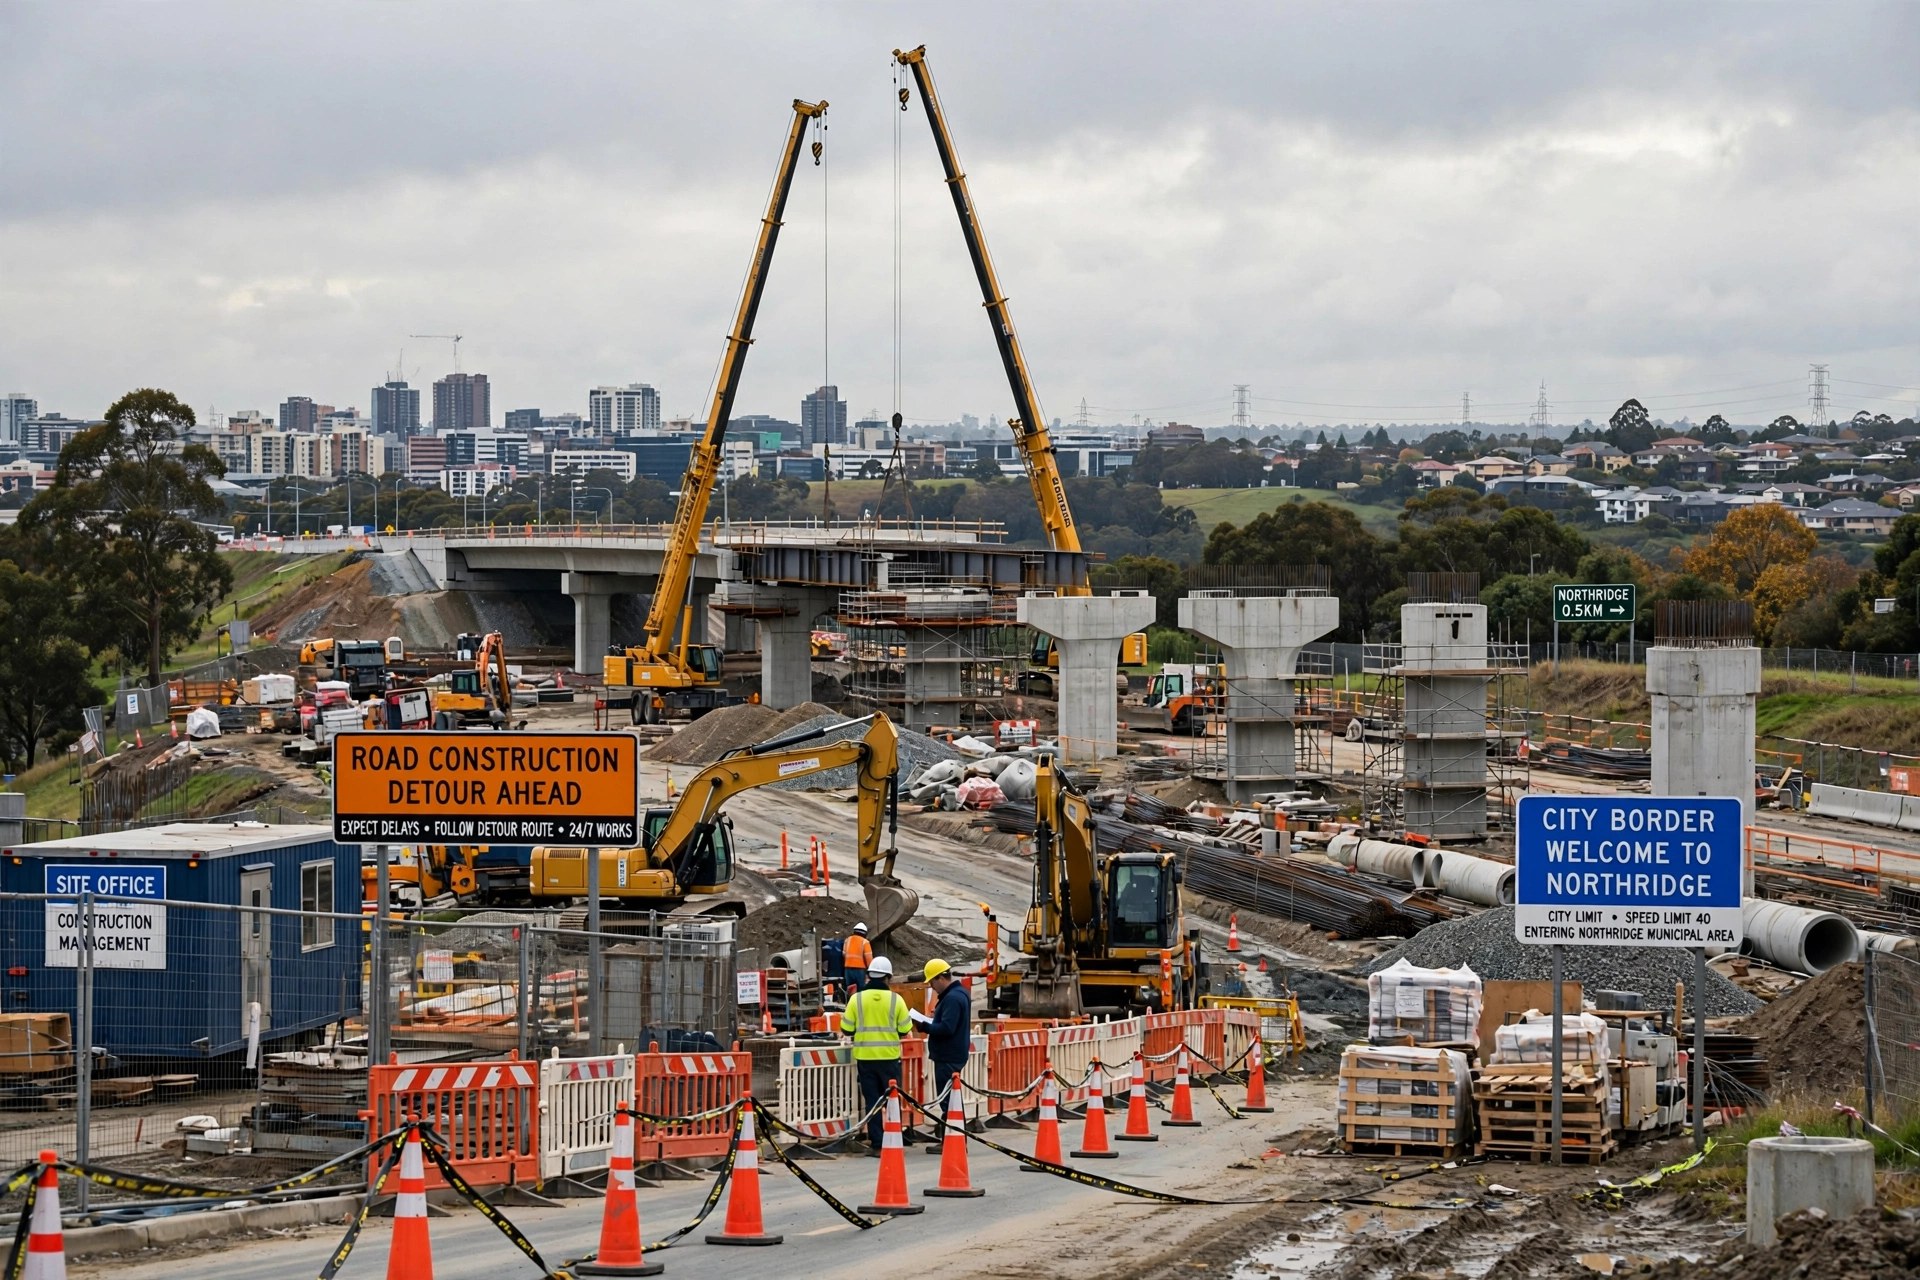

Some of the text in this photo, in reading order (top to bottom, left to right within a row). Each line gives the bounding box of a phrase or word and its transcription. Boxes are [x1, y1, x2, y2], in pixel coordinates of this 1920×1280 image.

[1558, 588, 1629, 601] NORTHRIDGE
[1562, 603, 1603, 617] 0.5KM
[351, 745, 619, 773] ROAD CONSTRUCTION
[388, 779, 582, 806] DETOUR AHEAD
[341, 819, 633, 839] EXPECT DELAYS FOLLOW DETOUR ROUTE 24/7 WORKS
[1542, 807, 1715, 832] CITY BORDER
[1546, 840, 1711, 865] WELCOME TO
[56, 875, 155, 895] SITE OFFICE
[1547, 872, 1712, 897] NORTHRIDGE
[1548, 910, 1711, 925] CITY LIMIT SPEED LIMIT 40
[1524, 925, 1735, 942] ENTERING NORTHRIDGE MUNICIPAL AREA
